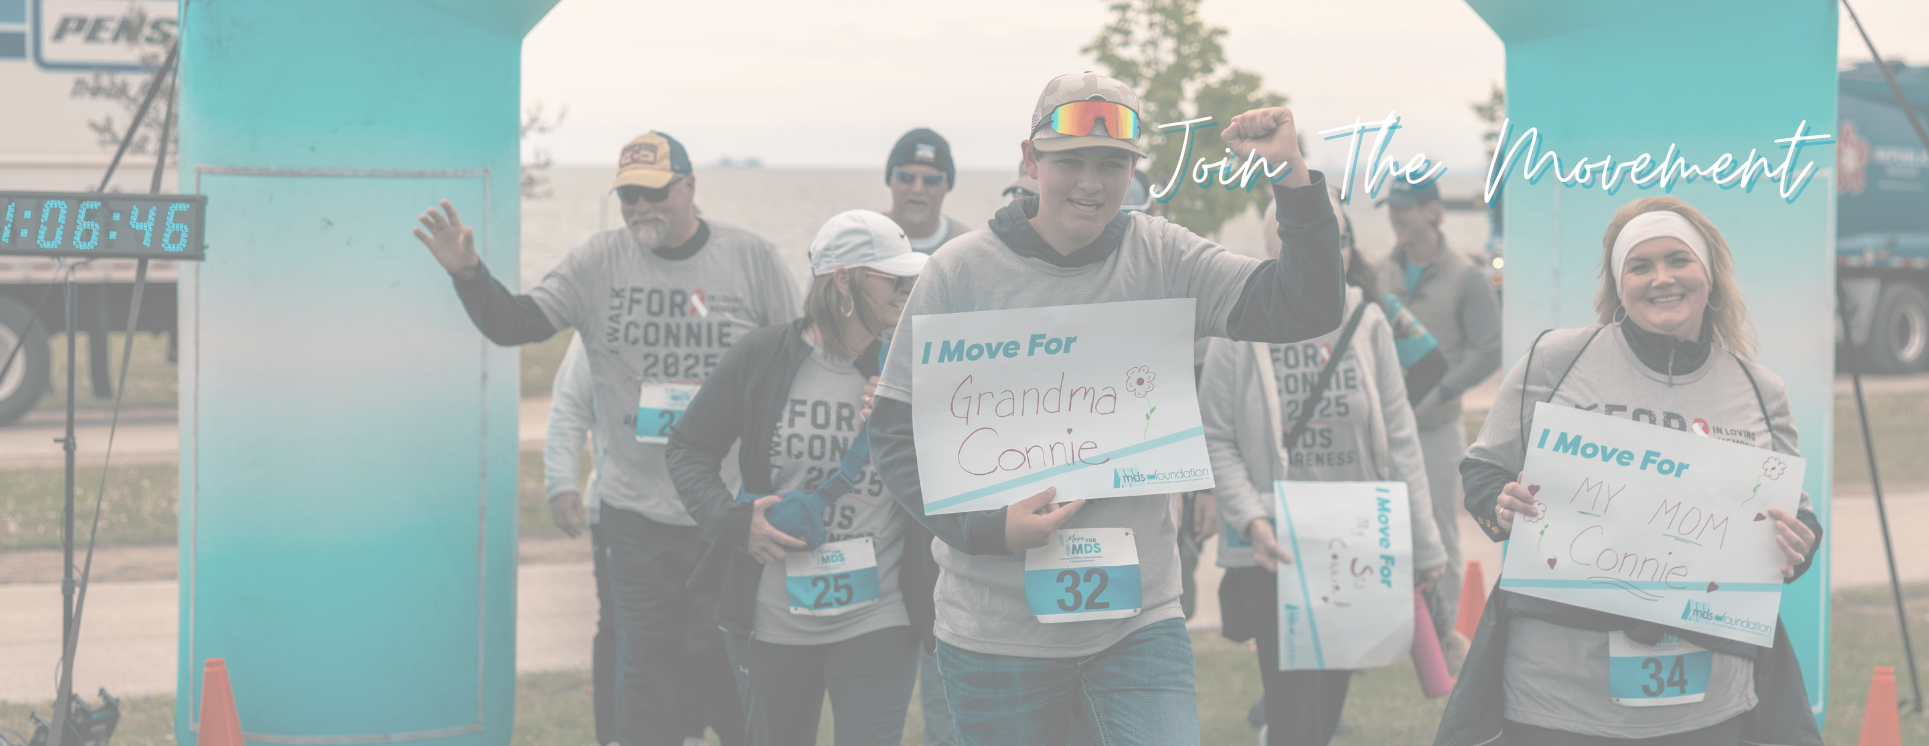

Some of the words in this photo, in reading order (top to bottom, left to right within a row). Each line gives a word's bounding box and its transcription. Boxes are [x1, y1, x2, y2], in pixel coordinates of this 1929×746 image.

[607, 286, 626, 343] WALK
[627, 286, 687, 317] FOR
[624, 321, 732, 348] CONNIE
[921, 341, 933, 365] I
[937, 337, 1021, 364] Move
[1027, 333, 1078, 357] For
[1271, 344, 1318, 369] FOR
[1275, 367, 1357, 395] ONIE
[788, 398, 855, 432] FOR
[950, 372, 1117, 426] Grandma
[1286, 394, 1350, 422] 225
[1712, 426, 1723, 435] IN
[1725, 427, 1756, 442] LOVING
[957, 427, 1111, 476] Connie
[1536, 428, 1550, 449] I
[1552, 431, 1635, 467] Move
[1639, 449, 1691, 479] For
[1123, 471, 1146, 483] mds
[1154, 467, 1209, 481] foundation
[1376, 497, 1391, 549] Move
[1569, 476, 1627, 514] MY
[1648, 498, 1729, 550] MOM
[821, 553, 845, 565] MDS
[1071, 542, 1102, 555] MDS
[1569, 524, 1689, 591] Connie
[1379, 554, 1395, 588] For
[811, 573, 853, 609] 25
[1055, 567, 1110, 613] 32
[1692, 609, 1714, 621] mds
[1721, 612, 1772, 634] foundation
[1640, 655, 1689, 697] 34
